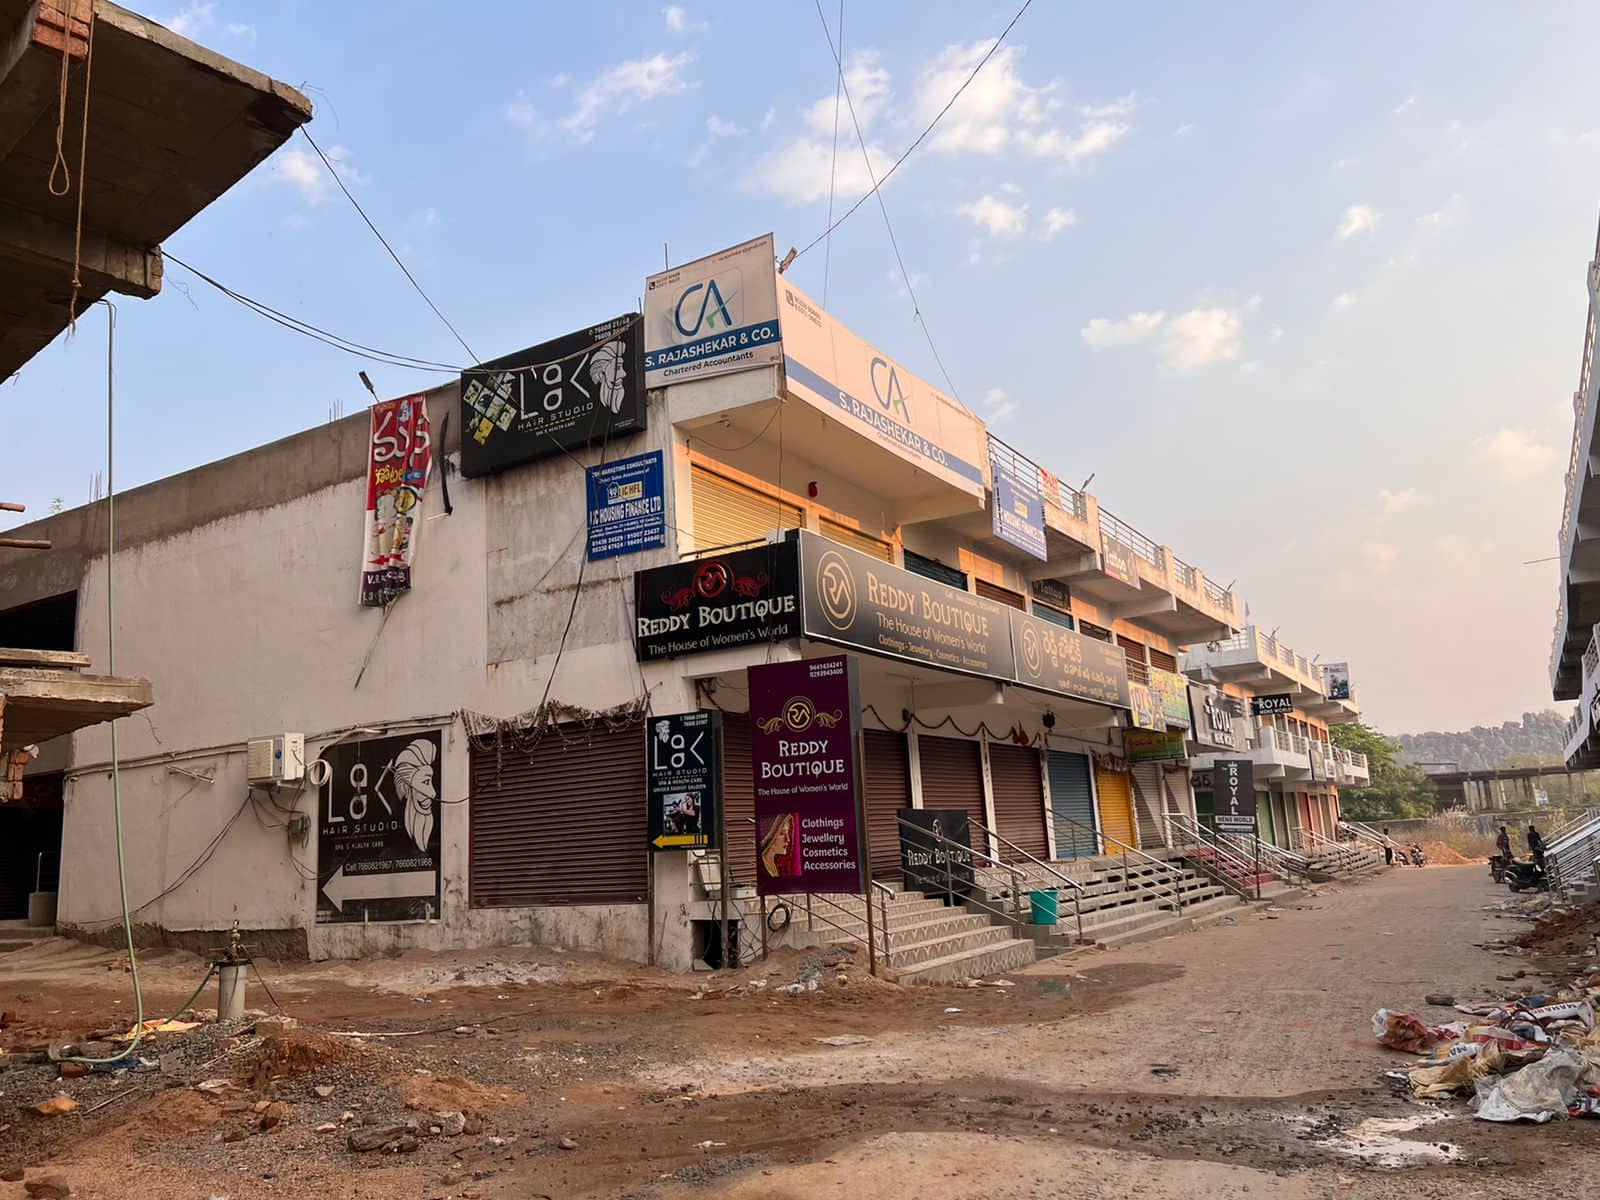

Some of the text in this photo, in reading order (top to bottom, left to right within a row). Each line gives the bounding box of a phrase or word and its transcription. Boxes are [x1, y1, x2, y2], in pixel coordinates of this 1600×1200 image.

[644, 327, 774, 368] S. RAJASHEKAR & CO.
[663, 350, 754, 376] Chartered Accountants
[550, 401, 595, 420] STUDIO
[838, 391, 851, 413] S.
[851, 401, 922, 454] RAJASHEKAR
[922, 442, 931, 457] &
[931, 445, 949, 466] CO.
[599, 503, 624, 524] HOUSING
[625, 497, 649, 519] FINANCE
[650, 495, 662, 512] LTD
[866, 571, 916, 616] REDDY
[921, 591, 989, 637] BOUTIQUE
[637, 594, 796, 638] REDDY BOUTIQUE
[648, 623, 789, 656] The House of Women's World
[876, 611, 987, 653] The House of Women's World
[1259, 697, 1292, 710] ROYAL
[778, 740, 829, 757] REDDY
[676, 767, 708, 776] STUDIO
[761, 759, 845, 779] BOUTIQUE
[758, 782, 849, 797] The House of Women's World
[322, 820, 399, 835] HAIR STUDIO
[801, 817, 844, 830] Clothings
[801, 833, 845, 846] Jewellery
[803, 846, 848, 858] Cosmetics
[803, 860, 856, 870] Accessories
